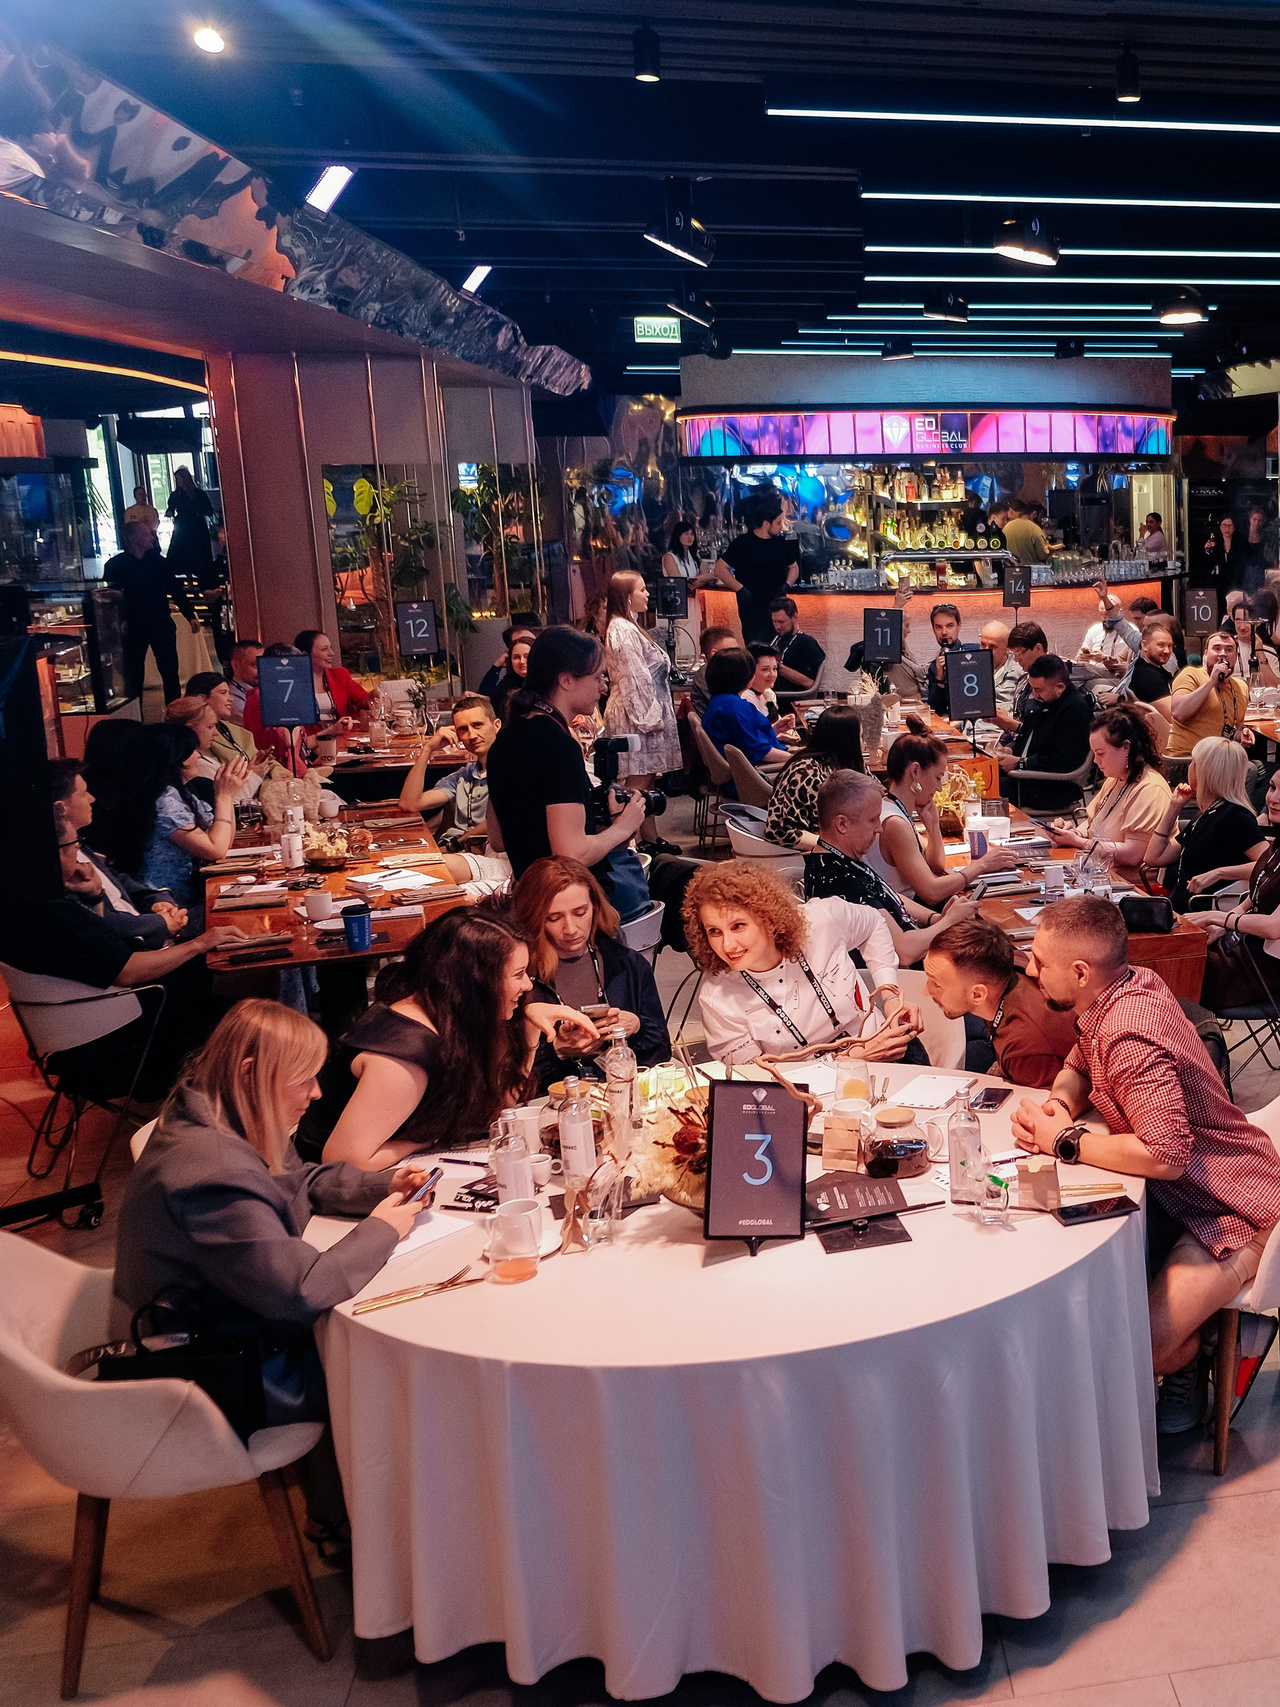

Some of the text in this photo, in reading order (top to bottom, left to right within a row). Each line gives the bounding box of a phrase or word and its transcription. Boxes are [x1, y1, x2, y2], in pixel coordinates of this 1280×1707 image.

[637, 323, 679, 339] ВЫХОД
[914, 417, 936, 431] ED
[916, 431, 967, 442] GLOBAL
[1009, 579, 1026, 594] 14
[1190, 604, 1212, 622] 10
[405, 618, 429, 639] 12
[874, 627, 891, 646] 11
[278, 679, 295, 703] 7
[963, 673, 979, 697] 8
[742, 1133, 773, 1186] 3
[738, 1218, 774, 1226] #EDGLOBAL
